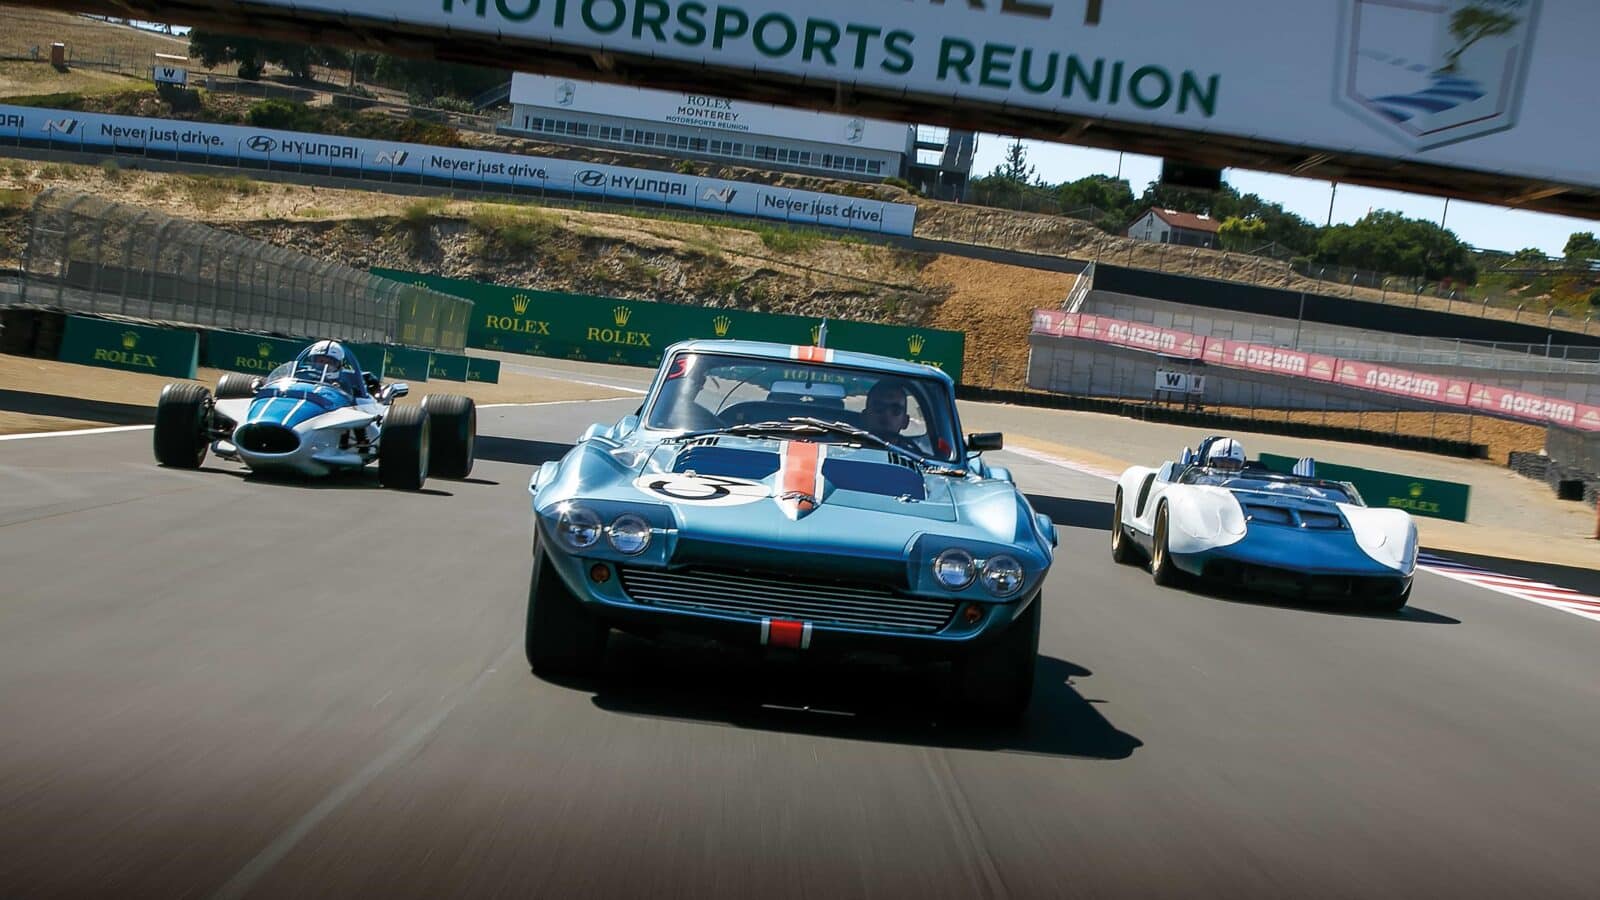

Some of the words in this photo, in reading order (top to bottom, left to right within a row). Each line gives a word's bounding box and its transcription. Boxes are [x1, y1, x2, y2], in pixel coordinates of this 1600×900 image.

[163, 68, 175, 78] W
[936, 36, 1222, 118] REUNION
[687, 95, 732, 110] ROLEX
[665, 115, 716, 128] MOTORSPORTS
[677, 106, 740, 121] MONTEREY
[100, 122, 146, 139] Never
[149, 129, 178, 142] just
[181, 130, 225, 147] drive.
[281, 139, 359, 160] HYUNDAI
[430, 155, 475, 172] Never
[476, 159, 505, 174] just
[507, 164, 550, 180] drive.
[610, 174, 687, 196] HYUNDAI
[764, 194, 809, 213] Never
[810, 199, 839, 216] just
[485, 314, 551, 336] ROLEX
[587, 327, 652, 347] ROLEX
[94, 348, 159, 368] ROLEX
[235, 356, 282, 371] ROLE
[1166, 373, 1181, 387] W
